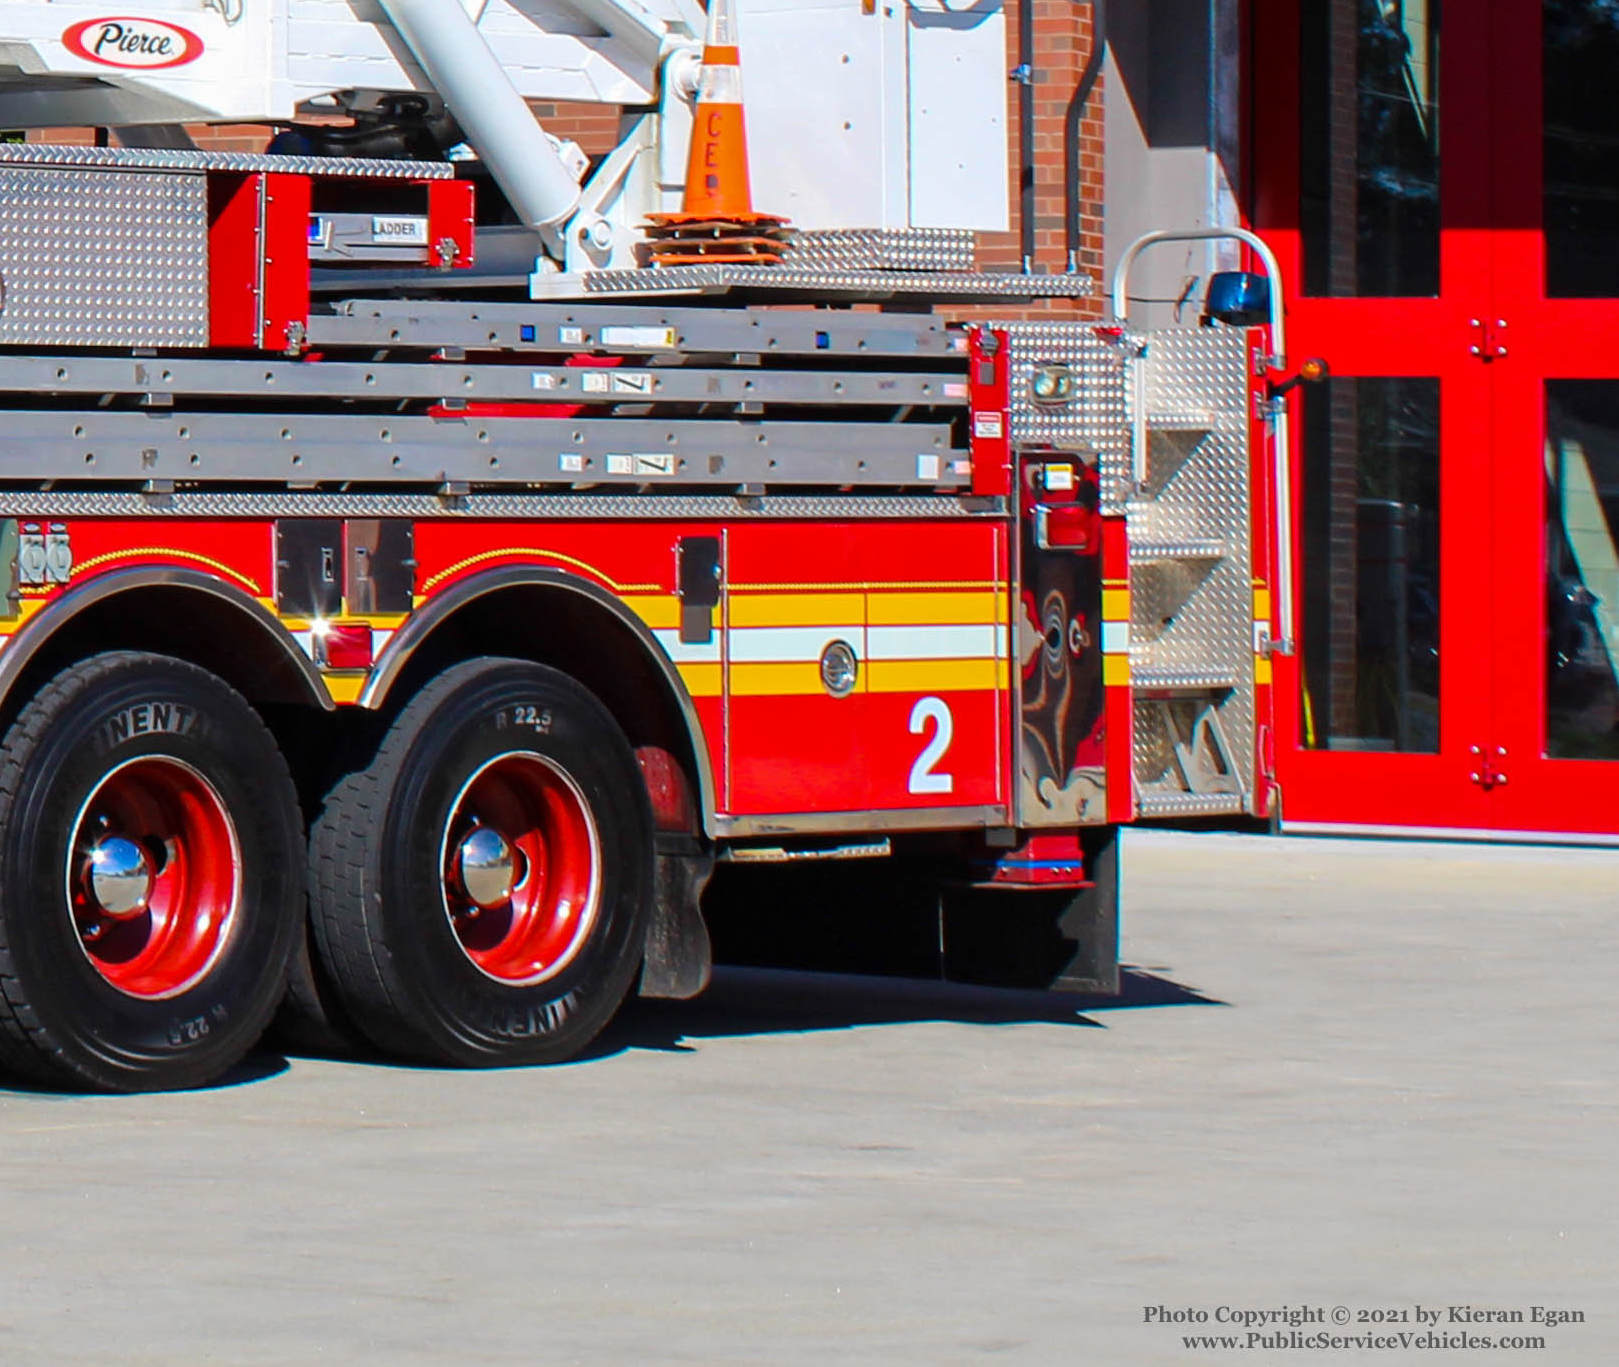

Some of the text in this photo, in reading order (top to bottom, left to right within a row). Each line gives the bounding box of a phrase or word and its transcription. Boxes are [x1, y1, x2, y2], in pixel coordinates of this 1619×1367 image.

[94, 22, 172, 55] Pierce
[372, 220, 416, 236] LADDER
[908, 696, 953, 794] 2
